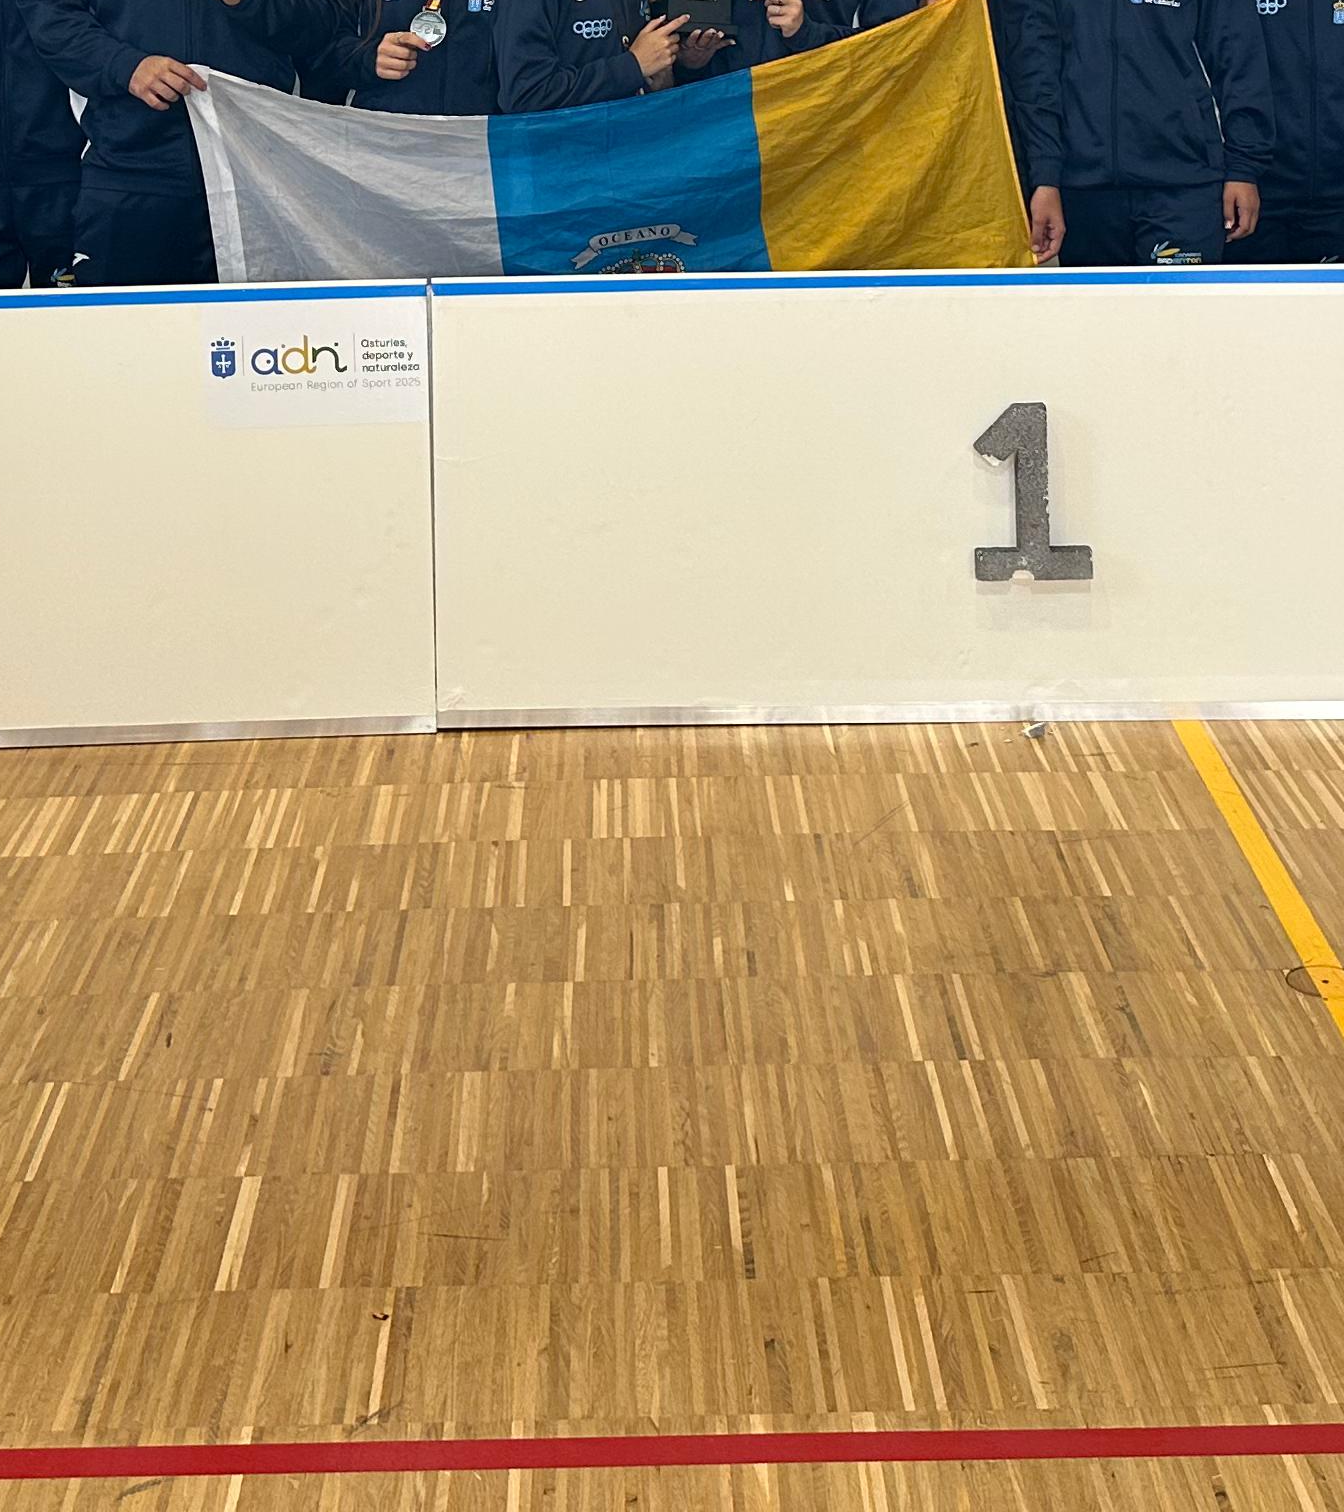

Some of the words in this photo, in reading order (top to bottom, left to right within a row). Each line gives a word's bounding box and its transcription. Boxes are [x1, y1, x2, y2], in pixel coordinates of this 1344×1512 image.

[598, 225, 671, 248] OCEANO
[362, 350, 404, 360] deporte
[407, 352, 413, 361] y
[362, 362, 420, 372] naturaleza
[251, 382, 302, 392] European
[307, 380, 343, 391] Region
[347, 379, 357, 388] of
[363, 379, 391, 389] Sport
[395, 377, 421, 387] 2025
[973, 402, 1093, 581] 1
